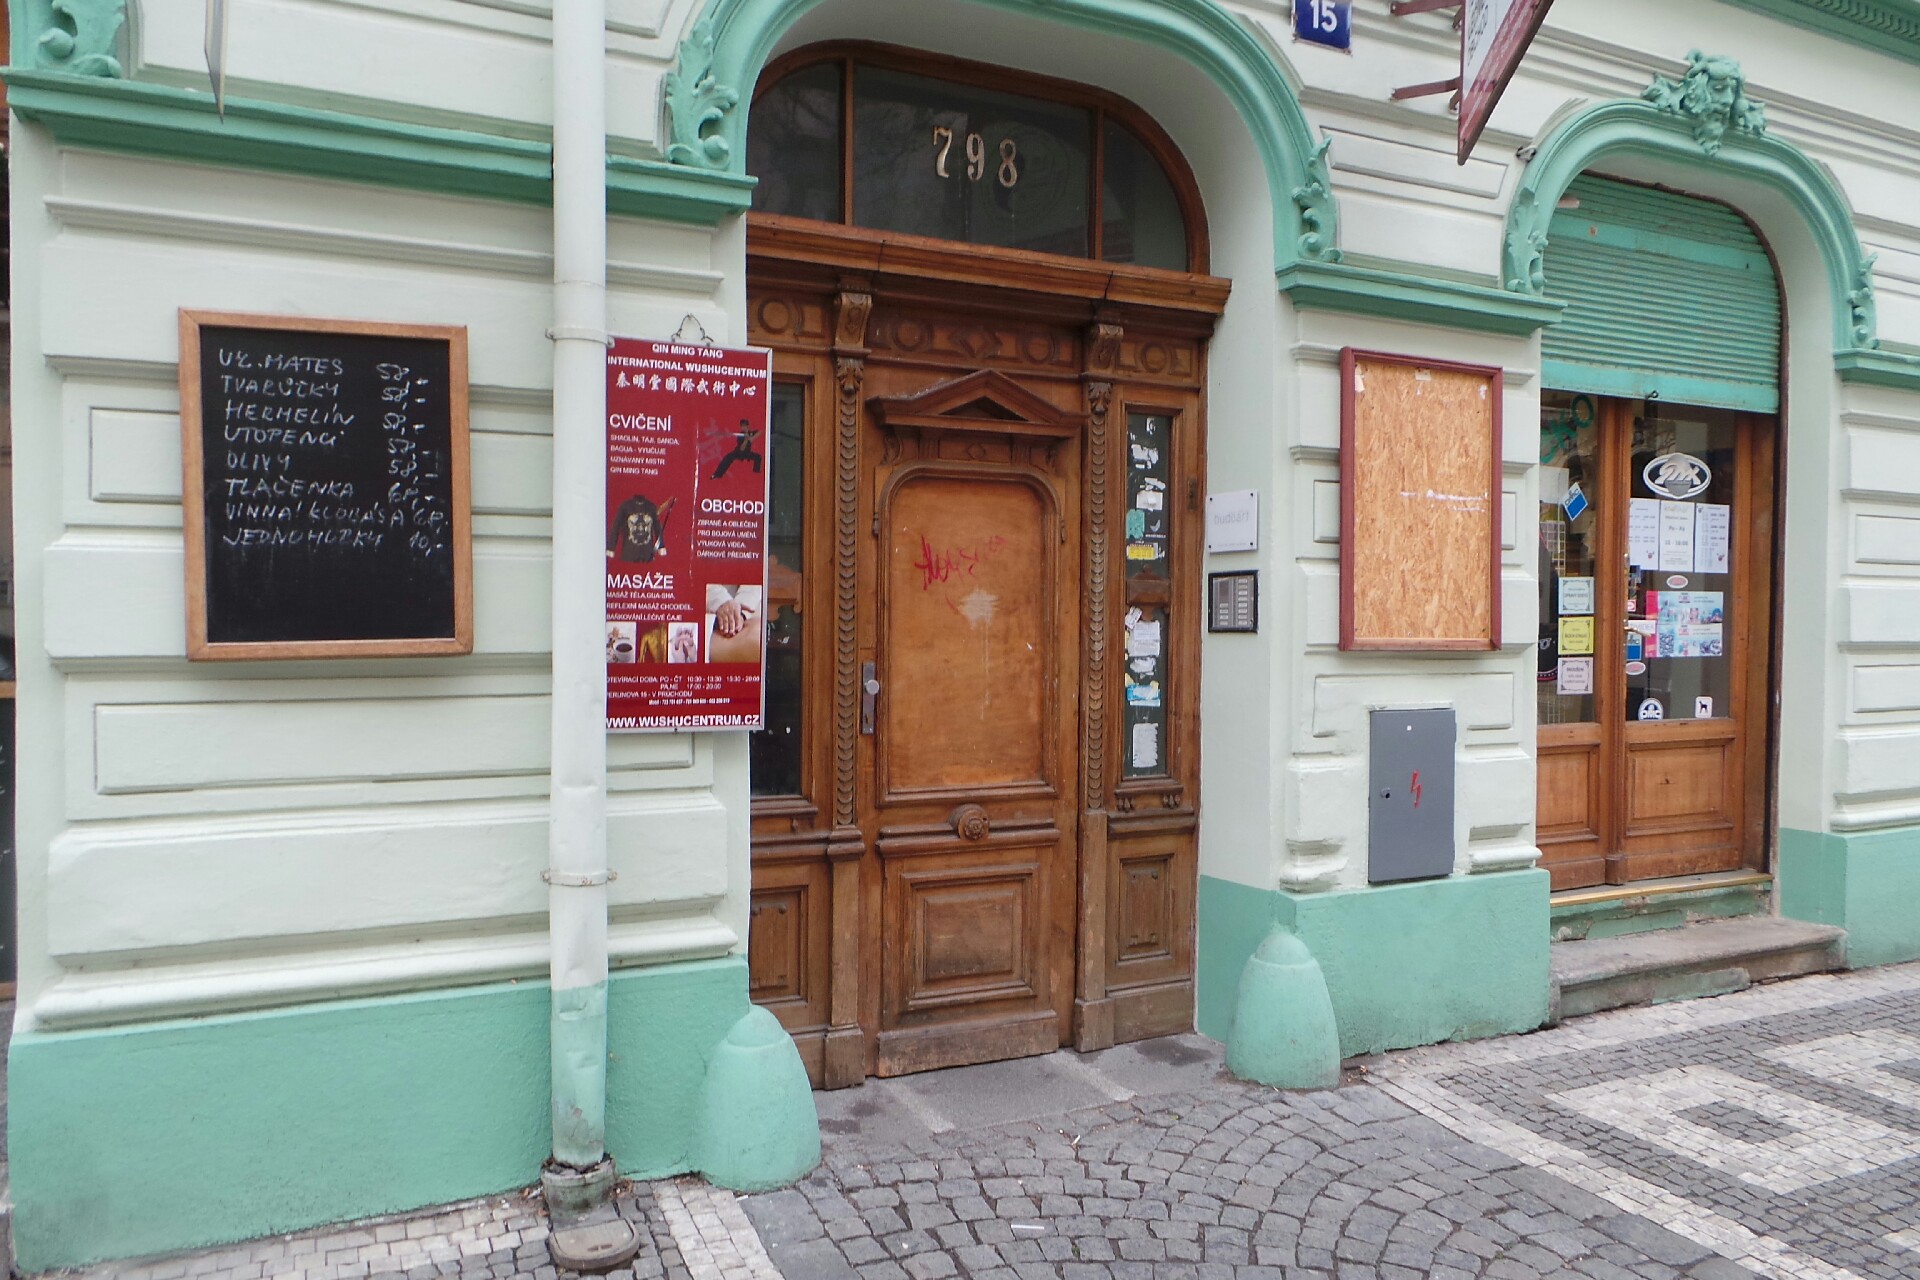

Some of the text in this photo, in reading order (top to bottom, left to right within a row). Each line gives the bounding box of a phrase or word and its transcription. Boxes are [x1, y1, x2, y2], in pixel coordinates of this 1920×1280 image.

[1310, 0, 1337, 33] 15
[933, 126, 1018, 188] 798
[652, 343, 724, 359] QIN MING TANG
[607, 355, 767, 379] INTERNATIONAL WUSHUCENTRUM
[609, 413, 672, 431] CVIČENÍ
[641, 467, 659, 475] TANG
[225, 475, 354, 498] TLAČENKA
[701, 498, 764, 515] OBCHOD
[728, 520, 758, 528] OBLEČENÍ
[697, 529, 711, 537] PRO
[711, 530, 736, 538] BOJOVÁ
[607, 571, 674, 589] MASÁŽE
[637, 602, 659, 610] MASÁŽ
[659, 675, 669, 683] PO
[673, 675, 682, 683] ČT
